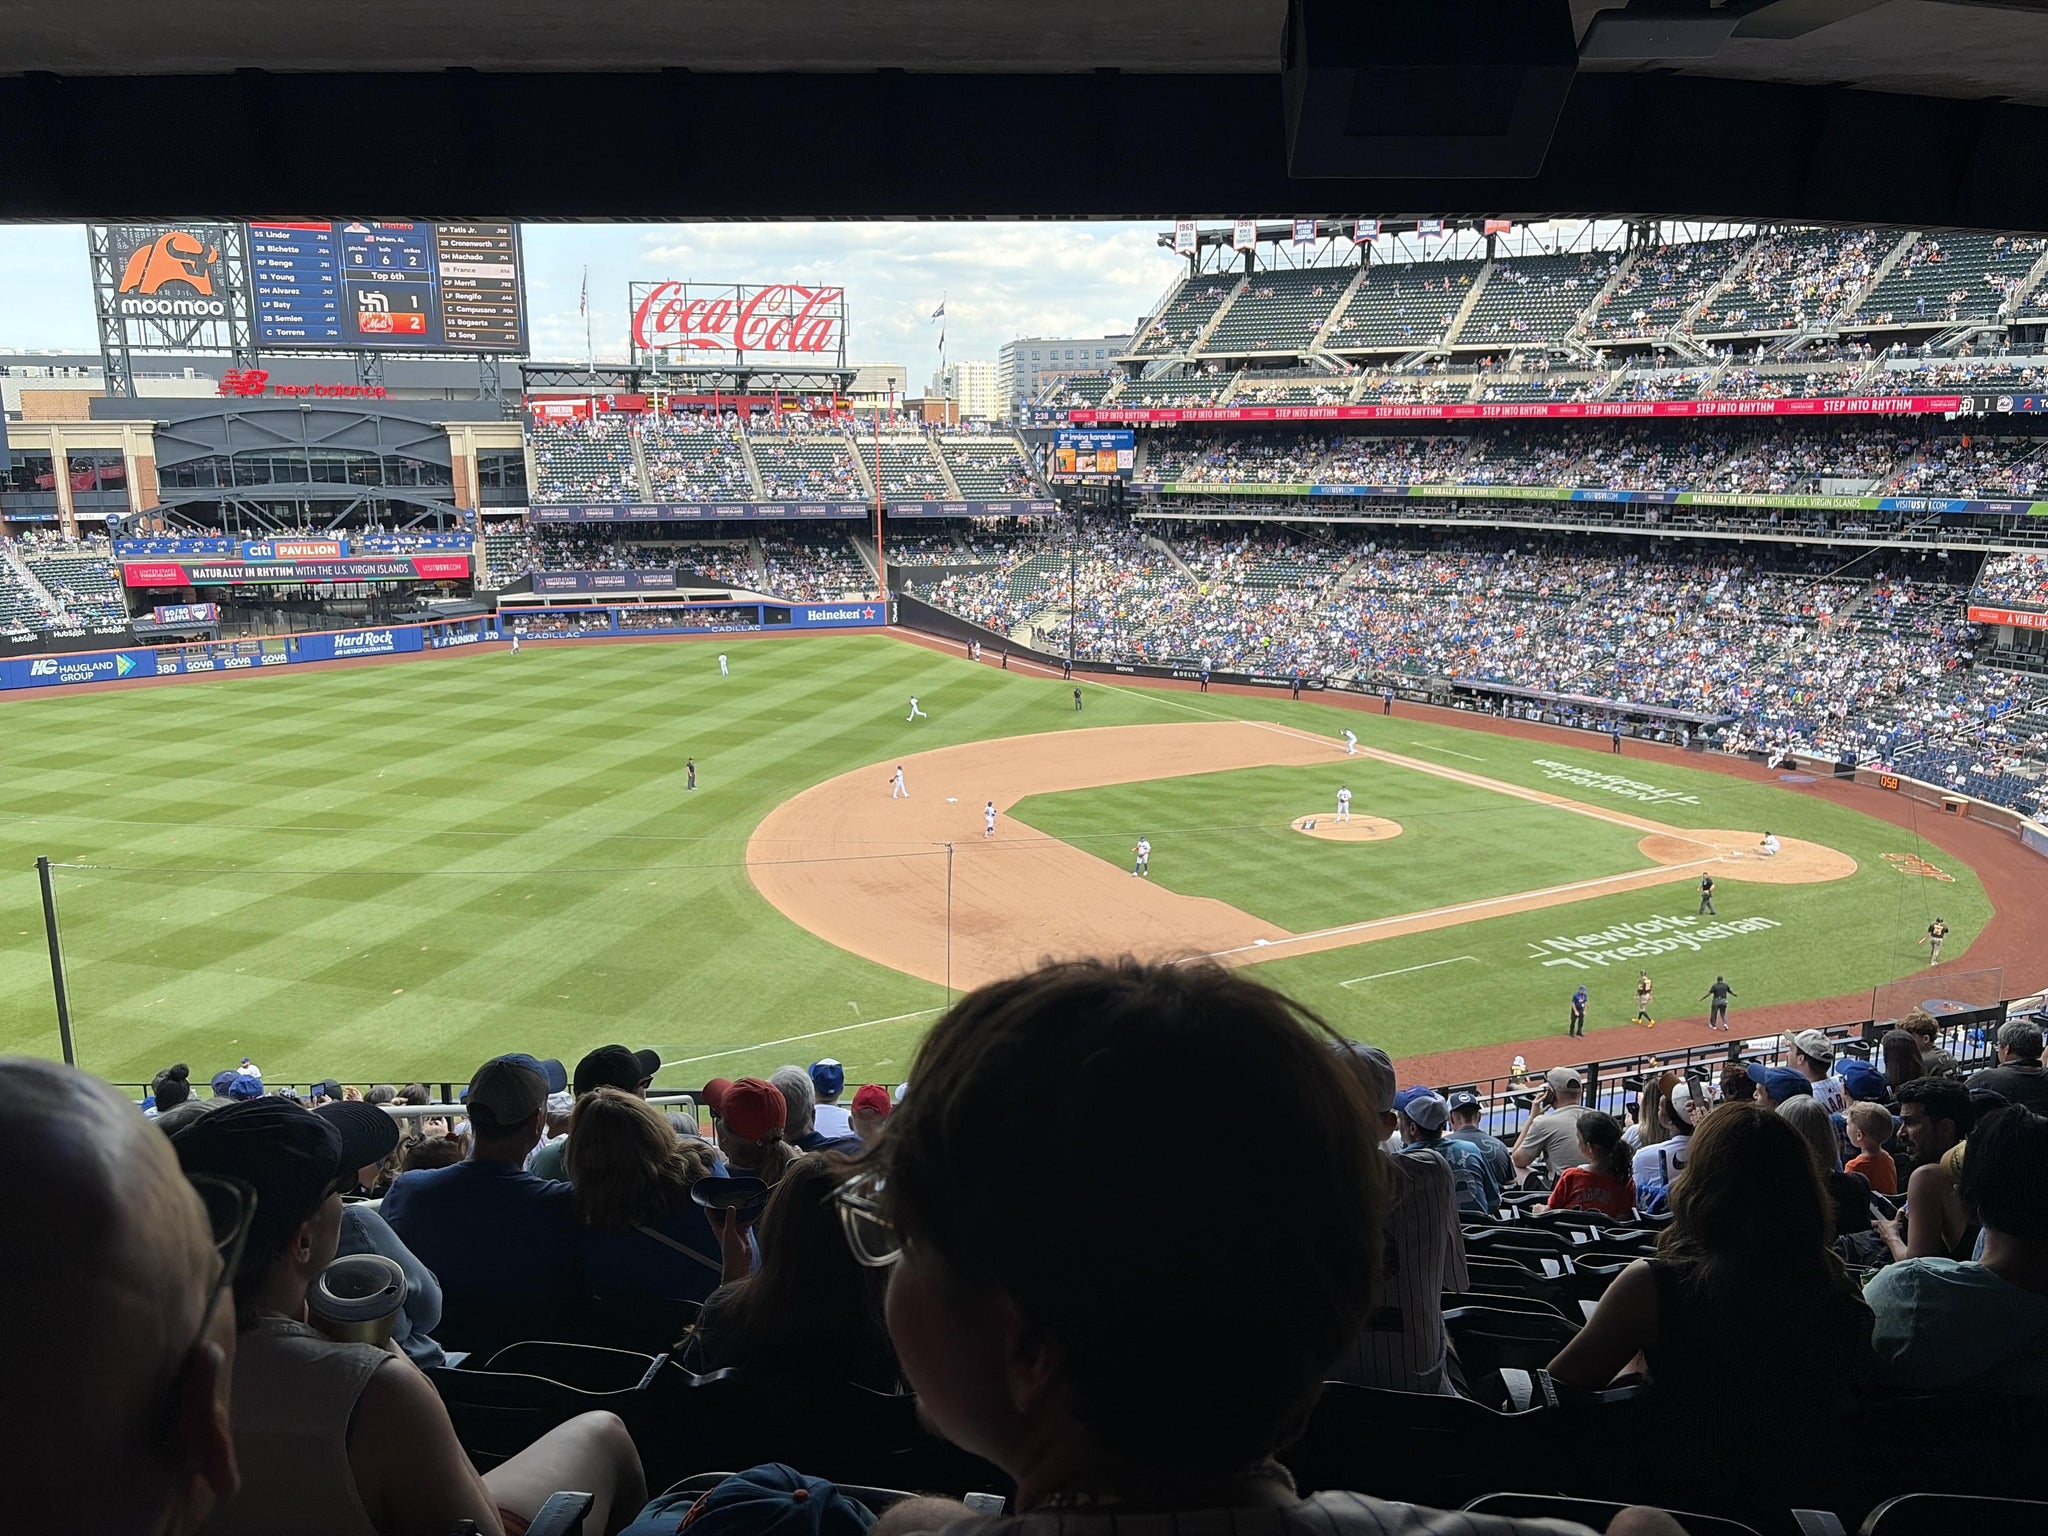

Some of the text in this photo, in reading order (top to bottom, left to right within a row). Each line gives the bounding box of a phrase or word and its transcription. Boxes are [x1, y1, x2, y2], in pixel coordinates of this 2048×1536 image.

[269, 260, 293, 268] Benge
[355, 254, 363, 264] 8
[382, 256, 390, 265] 6
[409, 256, 417, 266] 2
[270, 274, 295, 282] Young
[371, 272, 389, 281] Top
[411, 295, 417, 308] 1
[455, 293, 482, 301] Rengifo
[121, 300, 225, 316] moomoo
[456, 306, 496, 314] Campusano
[367, 319, 387, 329] Mets
[410, 317, 420, 329] 2
[274, 383, 387, 397] new balance
[1696, 404, 1716, 413] STEP
[1717, 403, 1736, 413] INTO
[1738, 402, 1774, 412] RHYTHM
[1823, 401, 1845, 411] STEP
[1847, 400, 1869, 410] INTO
[1872, 399, 1912, 410] RHYTHM
[1984, 398, 2033, 409] 1 2
[1375, 408, 1392, 416] STEP
[1393, 407, 1410, 416] INTO
[1412, 407, 1442, 416] RHYTHM
[1482, 406, 1500, 416] STEP
[1502, 406, 1518, 415] INTO
[1520, 406, 1548, 415] RHYTHM
[1585, 406, 1602, 415] STEP
[1603, 405, 1621, 414] INTO
[1622, 405, 1653, 414] RHYTHM
[1692, 495, 1860, 507] NATURALLY IN RHYTHM WITH THE U.S. VIRGIN ISLANDS
[250, 544, 335, 556] citi PAVILION
[192, 564, 408, 578] NATURALLY IN RHYTHM WITH THE U.S. VIRGIN ISLANDS
[808, 609, 860, 621] Heineken
[2007, 614, 2012, 624] A
[2015, 615, 2033, 625] VIBE
[2035, 617, 2047, 626] LIK
[54, 628, 86, 638] HubSpot
[94, 625, 126, 634] HubSpot
[12, 633, 38, 643] HubSpot
[334, 631, 392, 647] Hard Rock
[224, 657, 251, 666] GOYA
[261, 654, 287, 663] GOYA
[30, 659, 113, 676] HG HAUGLAND
[157, 664, 176, 674] 380
[187, 660, 214, 669] GOYA
[60, 671, 94, 681] GROUP
[1574, 916, 1782, 966] Presbyterian
